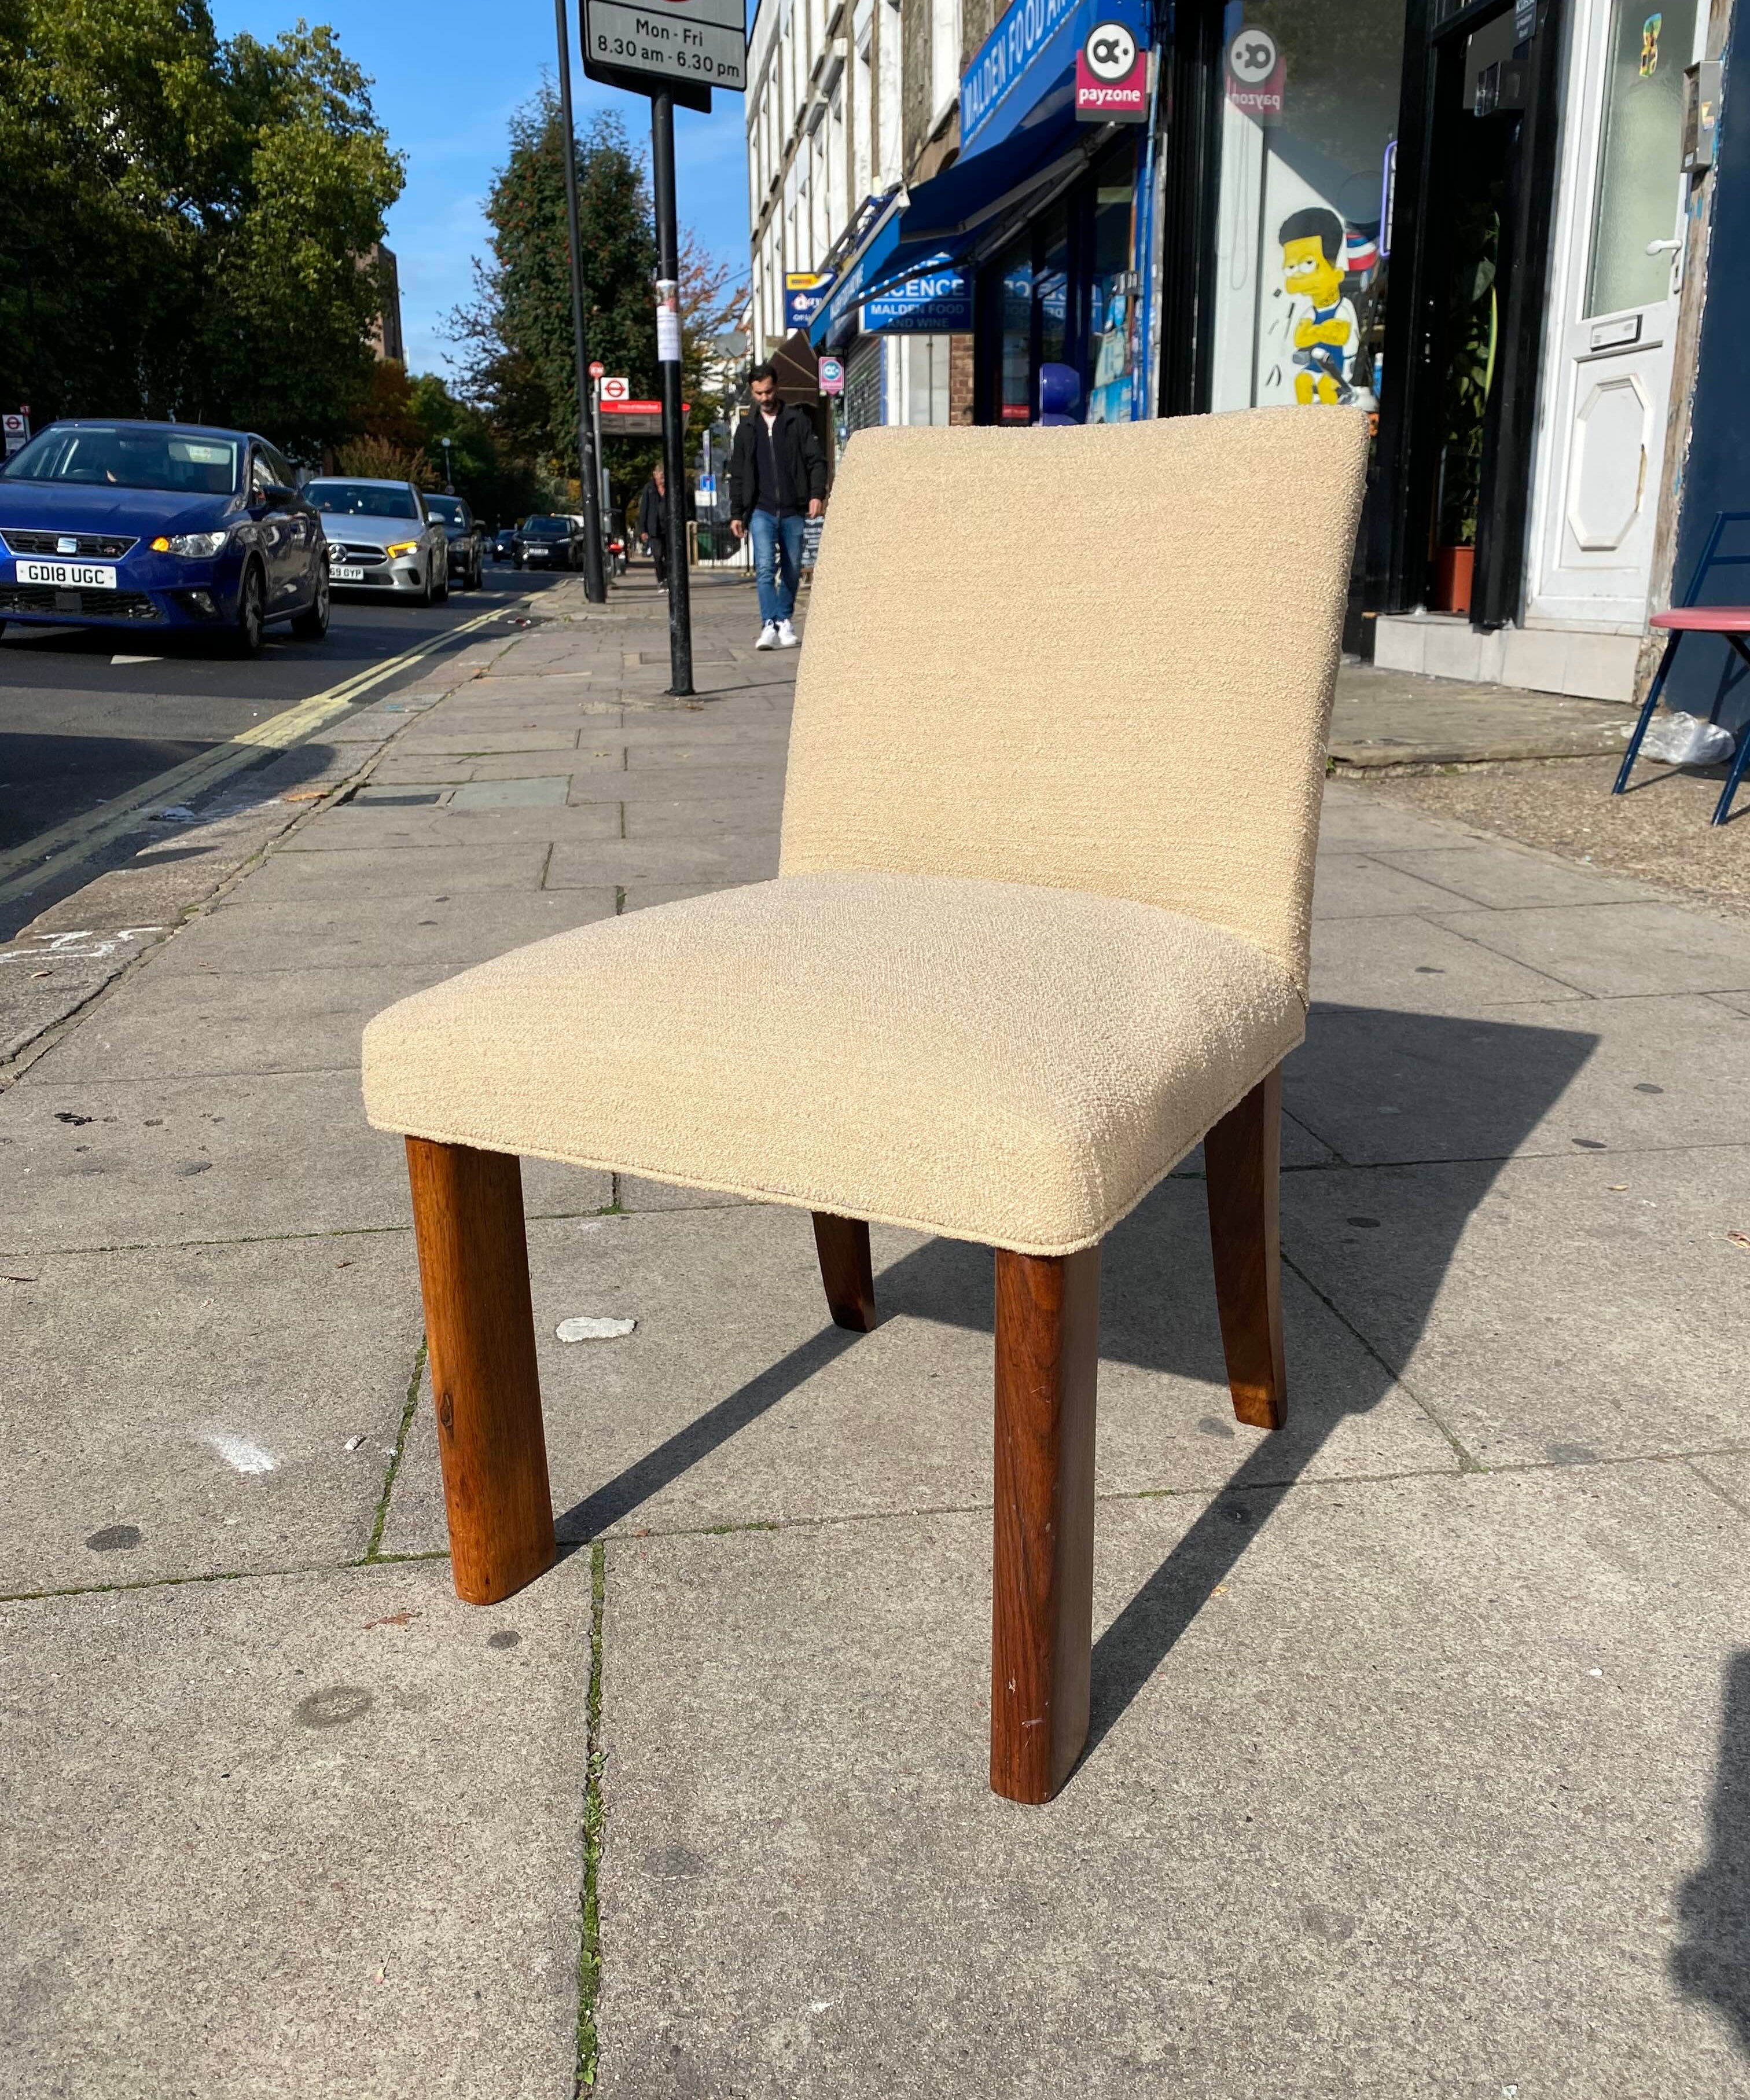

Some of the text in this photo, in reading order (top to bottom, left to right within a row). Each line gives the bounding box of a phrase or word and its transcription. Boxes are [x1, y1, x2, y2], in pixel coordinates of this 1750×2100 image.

[636, 18, 670, 40] Mon
[683, 28, 703, 47] Fri
[598, 35, 637, 57] 8.30
[641, 47, 664, 63] am
[677, 51, 714, 72] 6.30
[717, 62, 740, 78] pm
[964, 35, 1006, 133] MALDEN
[1079, 88, 1141, 105] payzone
[870, 304, 965, 315] MALDEN FOOD
[887, 318, 950, 328] AND WINE
[29, 565, 105, 584] GD18 UGC
